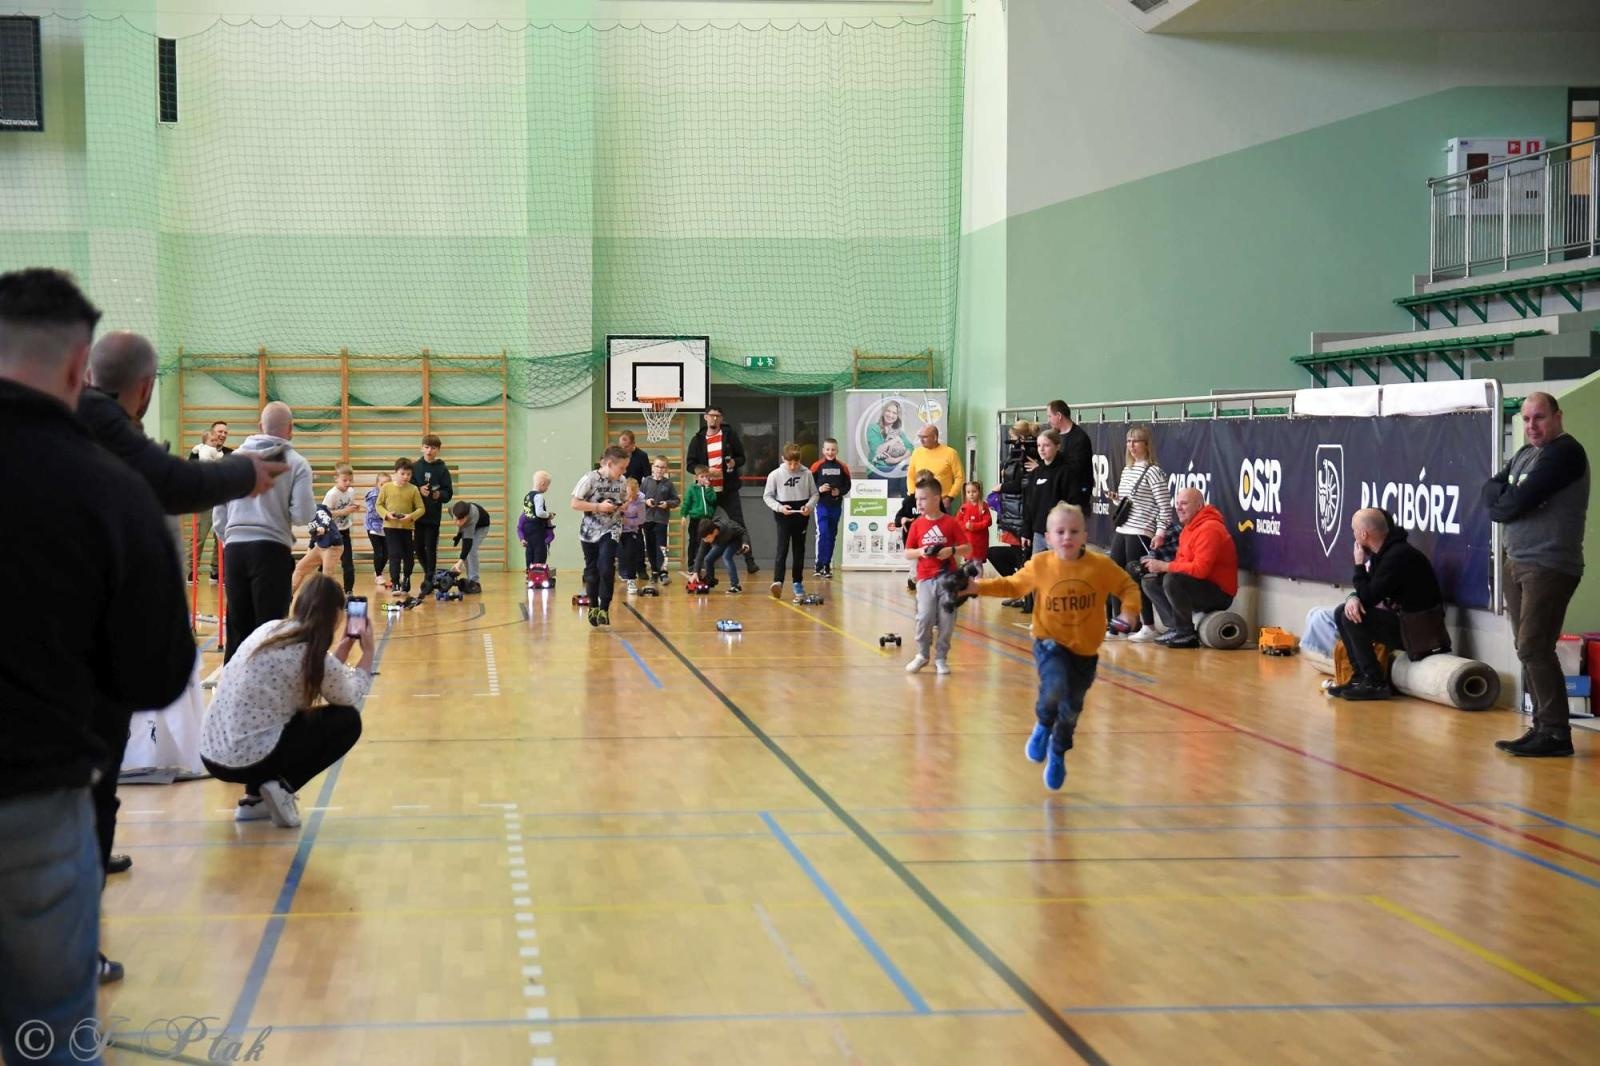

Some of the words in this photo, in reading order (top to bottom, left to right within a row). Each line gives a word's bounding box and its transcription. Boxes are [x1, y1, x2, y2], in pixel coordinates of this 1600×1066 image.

[784, 476, 801, 488] 4F
[921, 536, 948, 546] adidas
[1045, 591, 1097, 613] DETROIT
